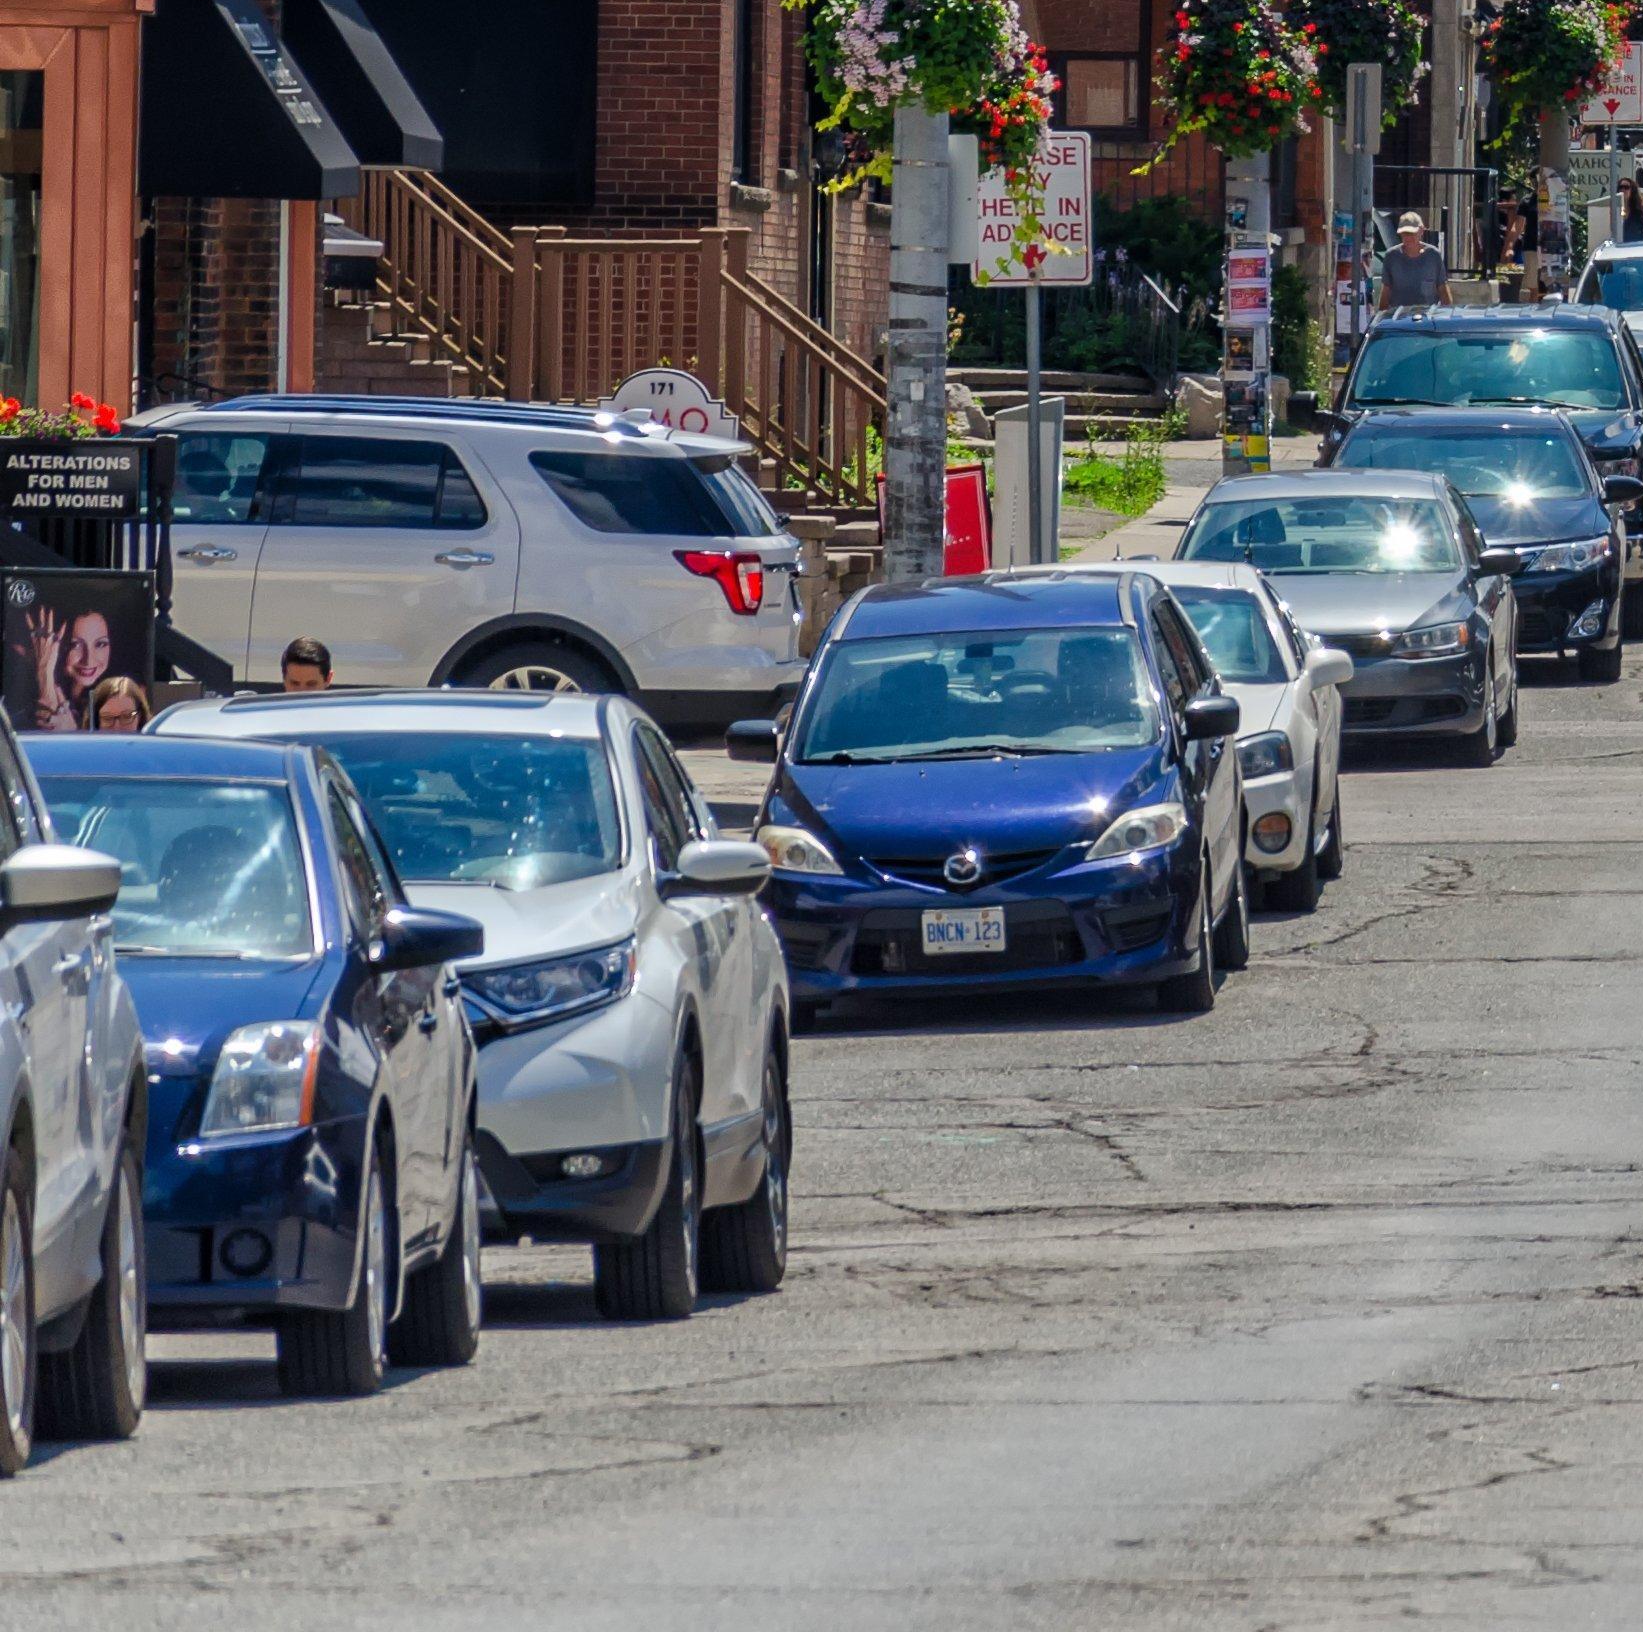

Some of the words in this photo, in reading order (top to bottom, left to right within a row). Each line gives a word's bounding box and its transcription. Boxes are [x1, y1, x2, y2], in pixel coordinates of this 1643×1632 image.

[1623, 74, 1634, 84] IN
[1025, 172, 1053, 191] AY
[1058, 197, 1081, 216] IN
[982, 222, 1083, 243] ADNCE
[650, 382, 674, 396] 171
[6, 454, 131, 471] ALTERATIONS
[27, 474, 65, 489] FOR
[68, 475, 109, 489] MEN
[12, 493, 51, 508] AND
[54, 494, 125, 509] WOMEN
[926, 921, 965, 943] BNCN
[974, 921, 1001, 941] 123
